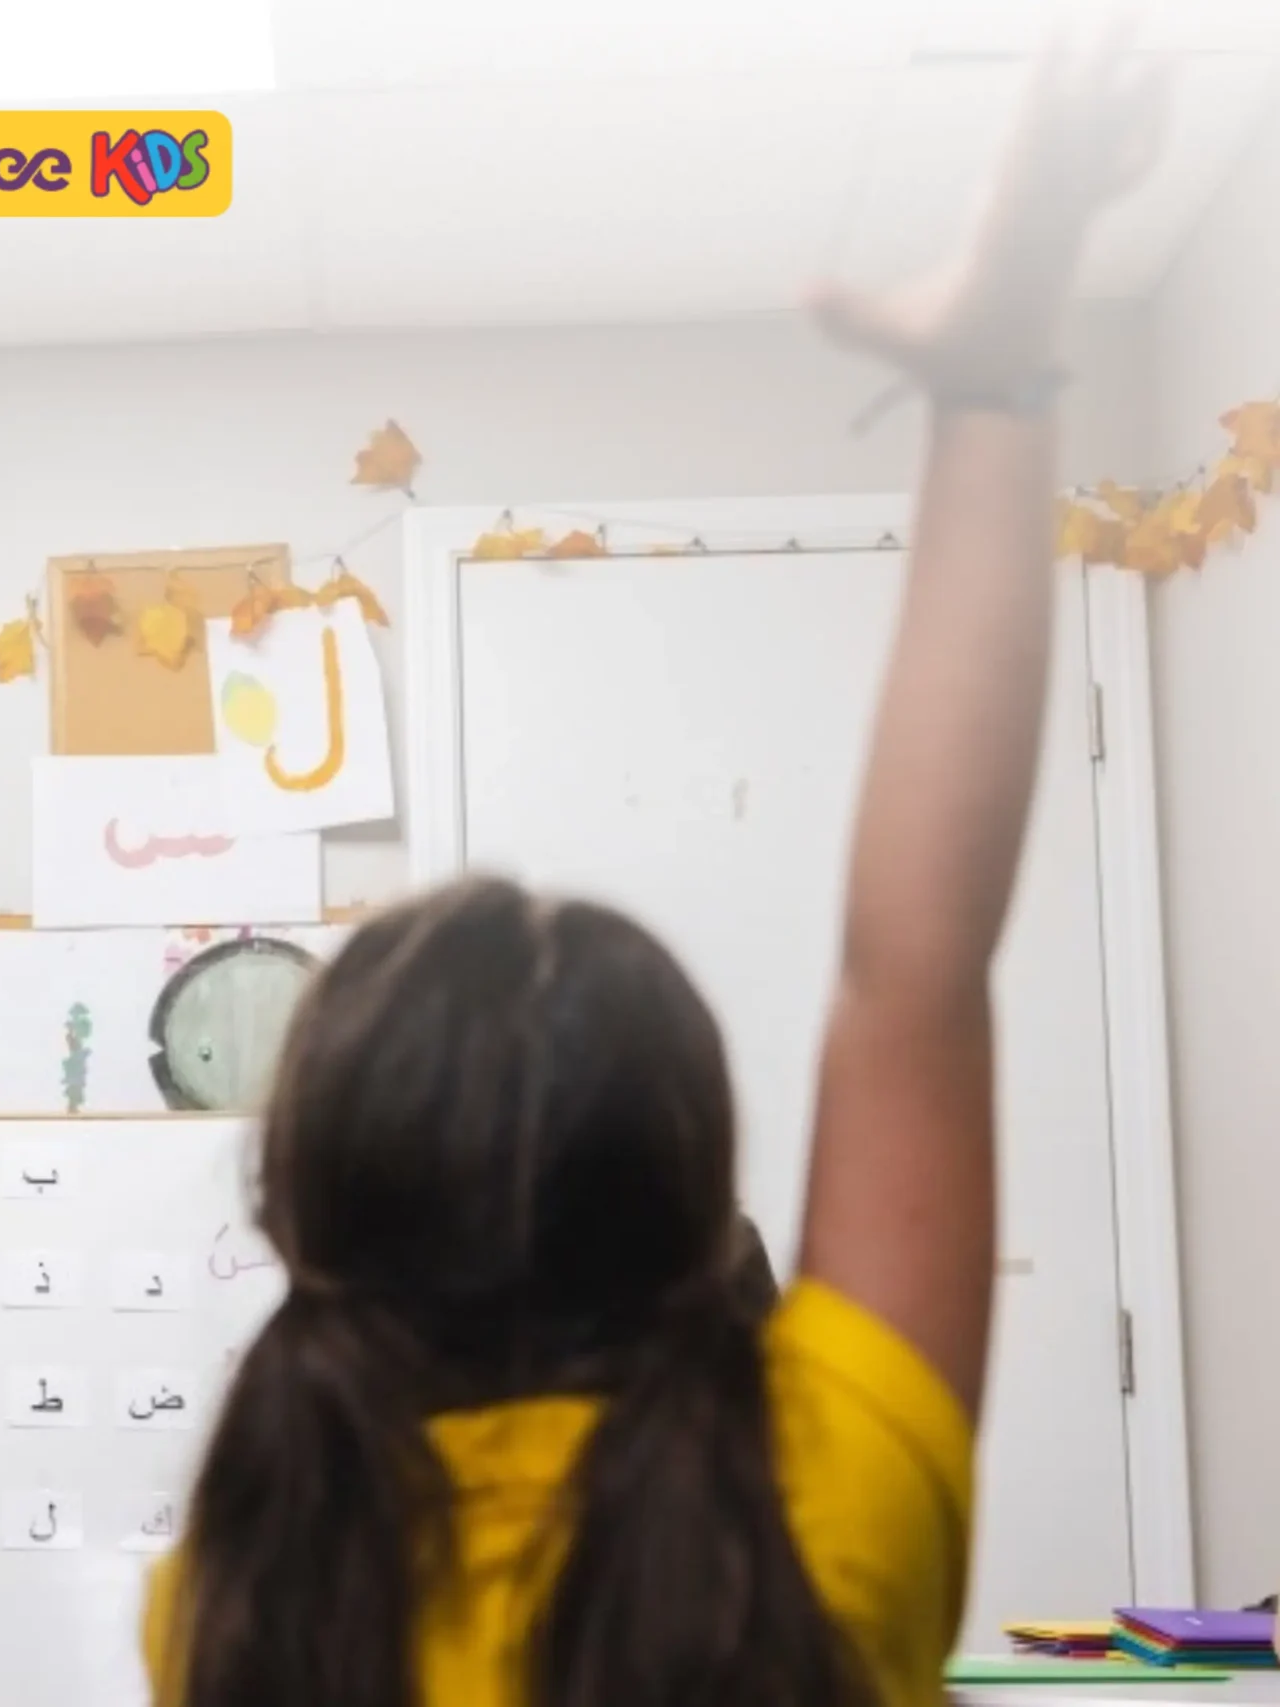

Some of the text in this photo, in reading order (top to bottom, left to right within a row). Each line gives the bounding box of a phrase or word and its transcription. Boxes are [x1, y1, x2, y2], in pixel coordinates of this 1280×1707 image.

[22, 1169, 59, 1194] ب
[144, 1274, 164, 1298] د
[30, 1378, 64, 1413] ط
[127, 1386, 186, 1421] ض
[29, 1501, 57, 1542] ل
